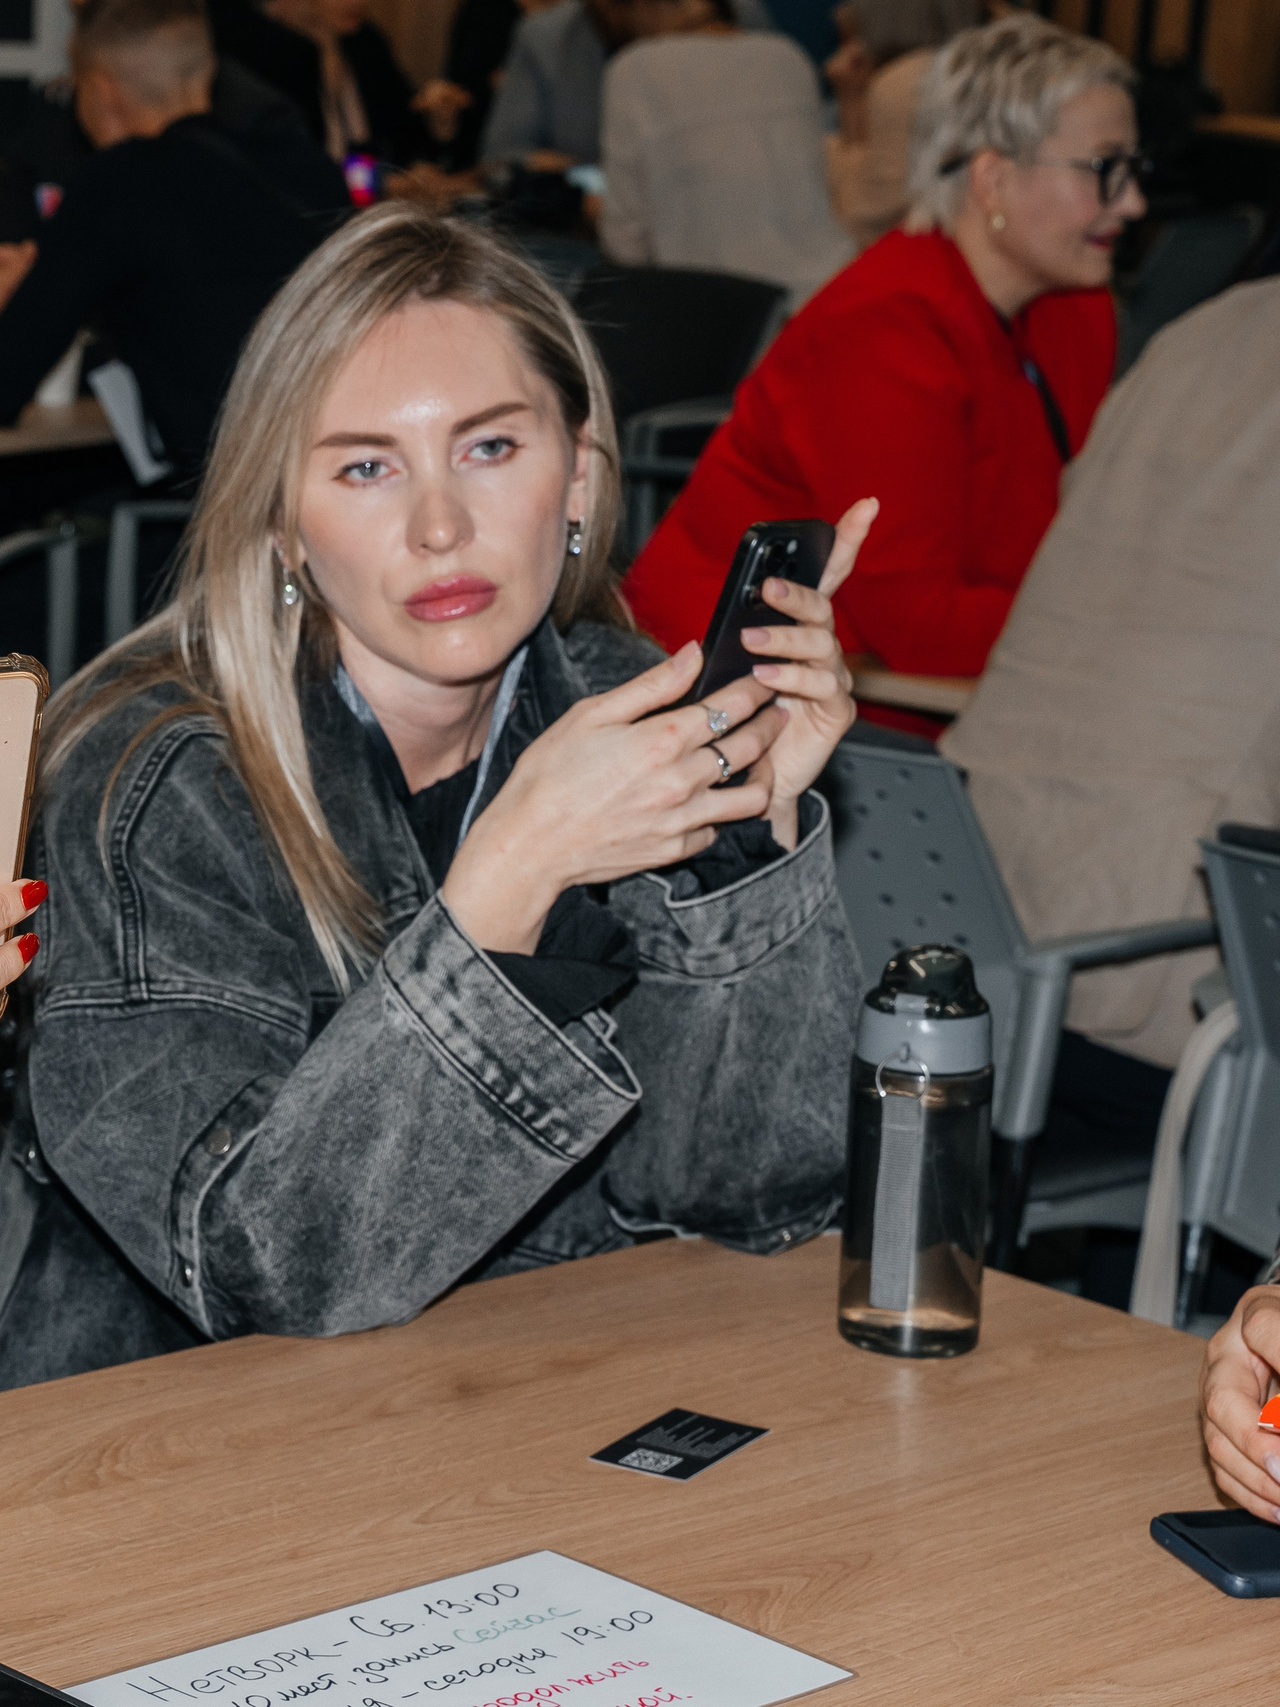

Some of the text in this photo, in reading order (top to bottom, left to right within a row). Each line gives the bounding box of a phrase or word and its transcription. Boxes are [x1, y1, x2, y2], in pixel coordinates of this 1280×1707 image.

[423, 1583, 520, 1620] 13:00
[352, 1642, 455, 1684] запись
[423, 1647, 558, 1690] сегодня
[560, 1610, 653, 1646] 19:00
[473, 1659, 650, 1707] одолжить
